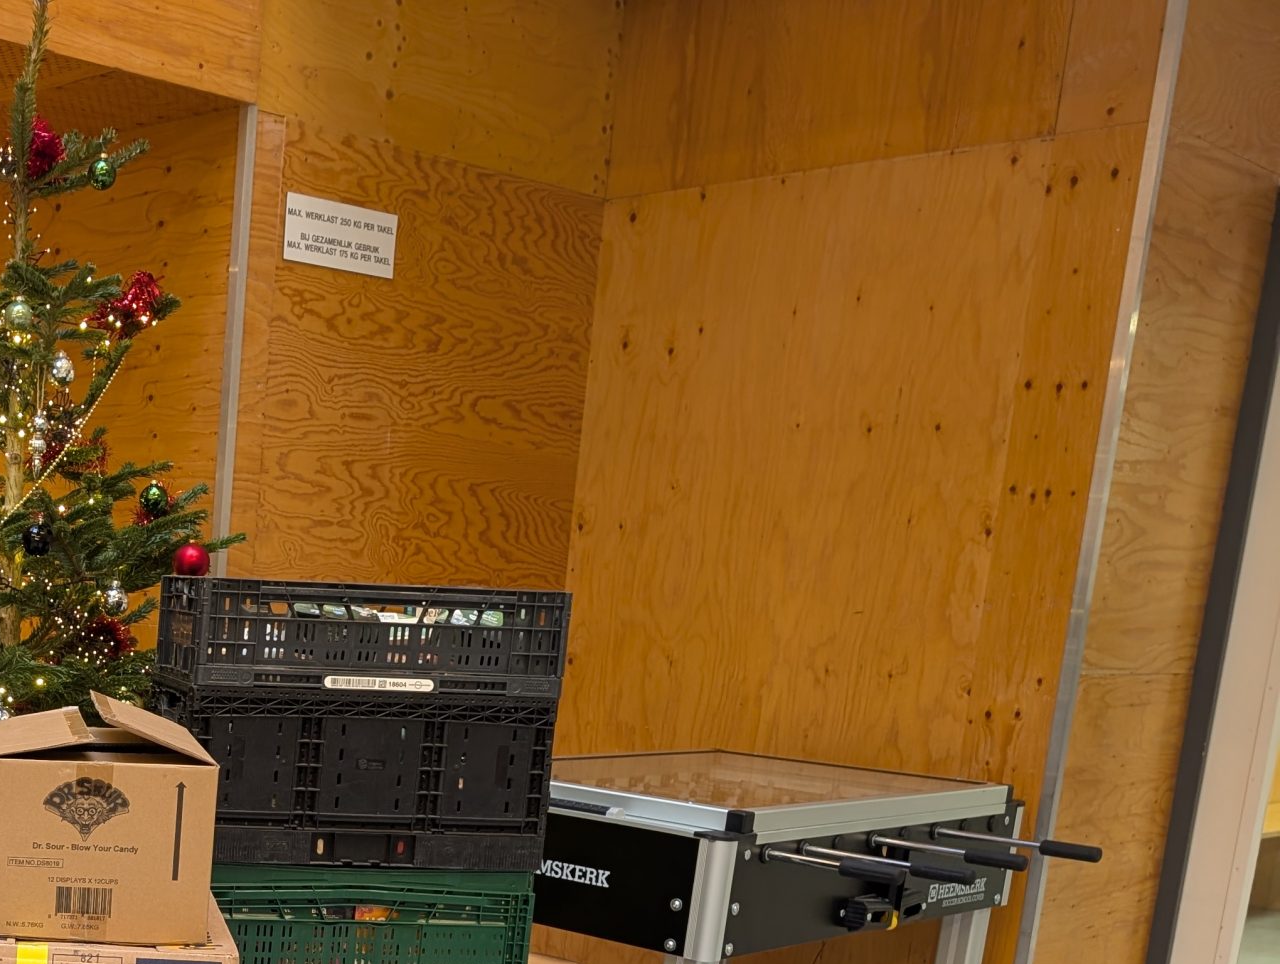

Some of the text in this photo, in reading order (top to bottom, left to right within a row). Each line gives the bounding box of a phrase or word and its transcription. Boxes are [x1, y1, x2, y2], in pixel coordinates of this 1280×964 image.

[288, 208, 394, 235] MAX. WERKLAST 250 KG PER TAKEL
[287, 240, 302, 250] MAX.
[305, 244, 337, 256] WERKLAST
[340, 249, 348, 258] 175
[350, 251, 359, 260] KG
[374, 256, 391, 265] TAKEL
[300, 233, 310, 241] BIJ
[355, 243, 379, 253] GEBRUIK
[33, 842, 44, 850] Dr.
[114, 845, 138, 854] Candy
